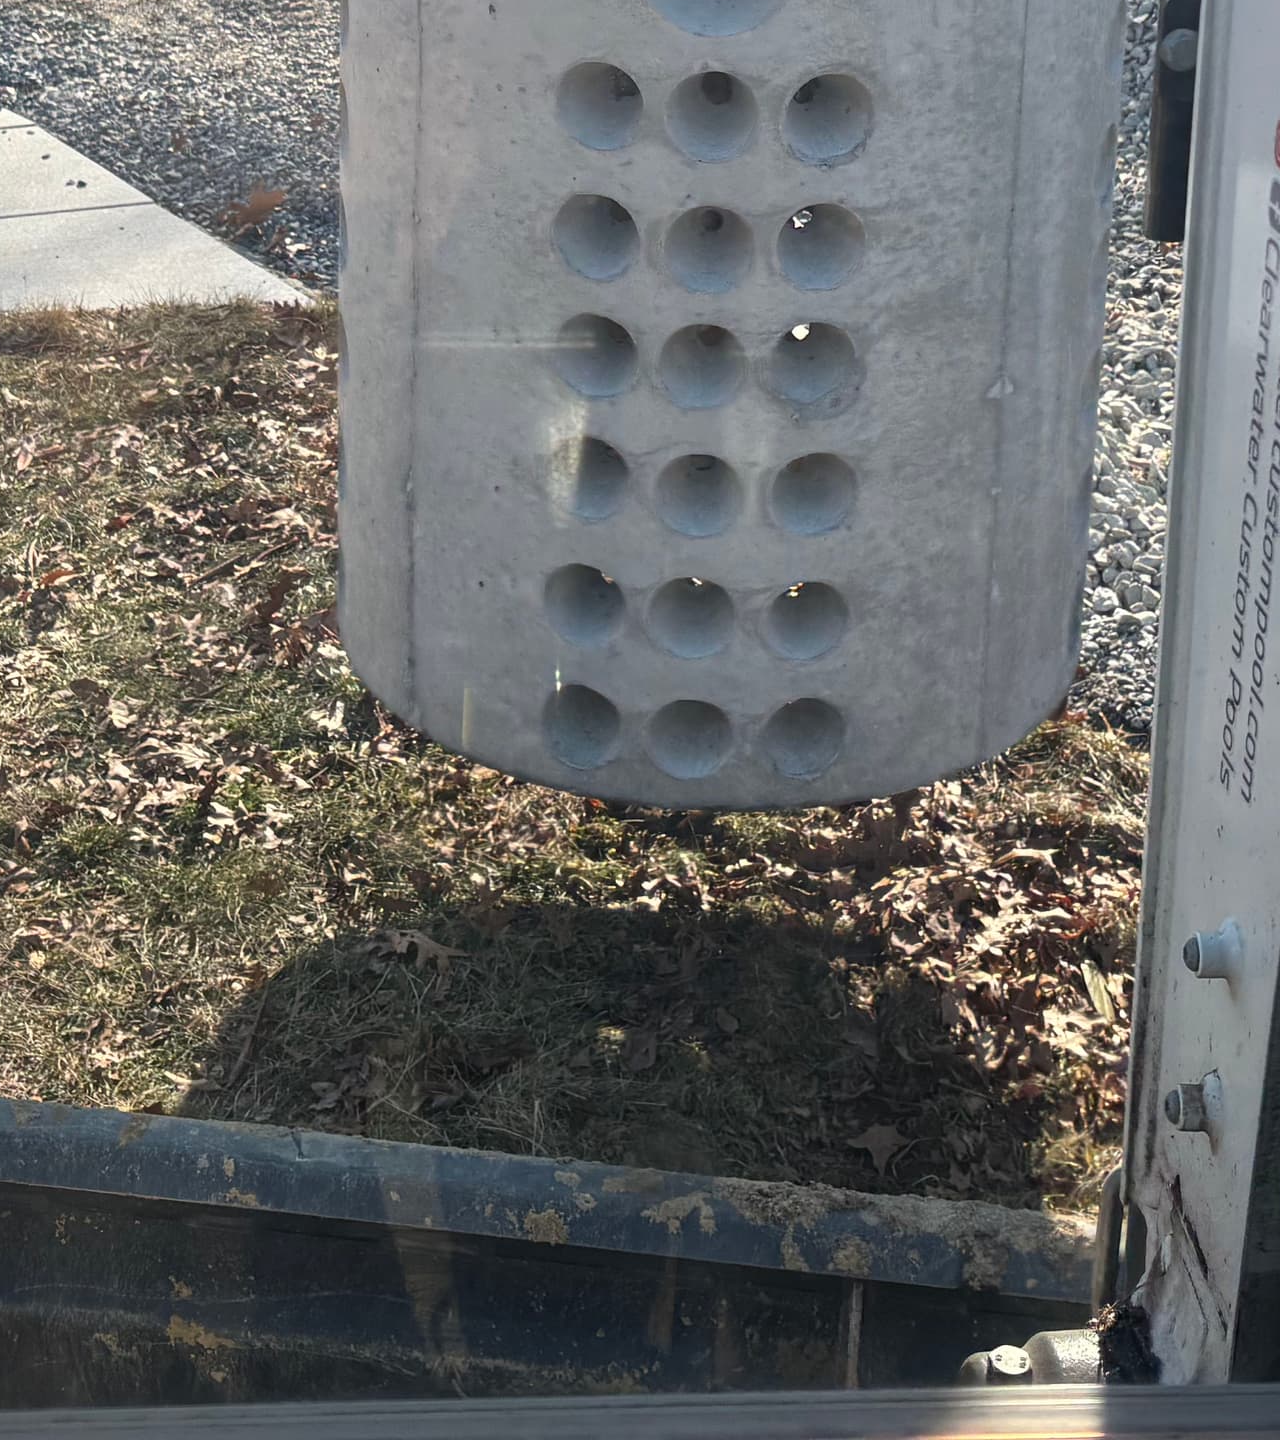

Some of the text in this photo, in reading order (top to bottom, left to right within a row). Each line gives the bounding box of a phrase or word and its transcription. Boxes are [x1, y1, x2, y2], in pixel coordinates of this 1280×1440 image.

[1220, 238, 1280, 791] Clearwater Custom Pools
